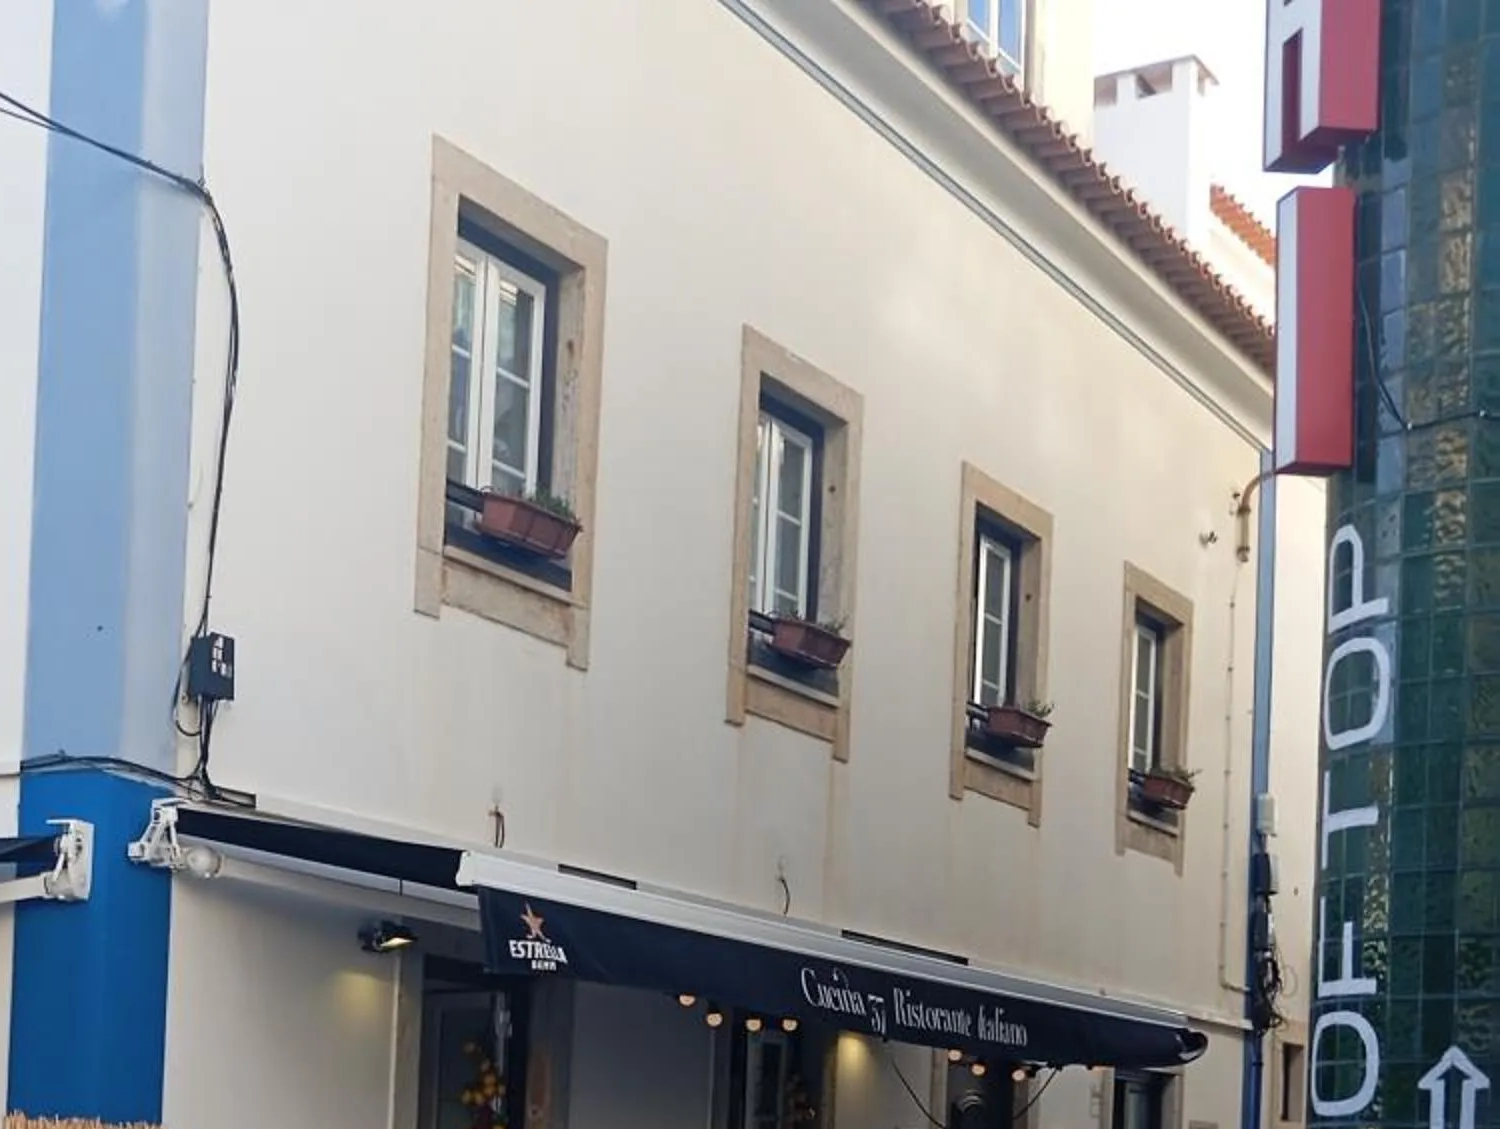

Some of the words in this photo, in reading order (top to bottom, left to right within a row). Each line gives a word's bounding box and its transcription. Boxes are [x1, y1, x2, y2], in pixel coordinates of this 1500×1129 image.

[801, 967, 867, 1017] Cucina
[893, 987, 973, 1037] Ristorante
[976, 1004, 1029, 1048] Italiano
